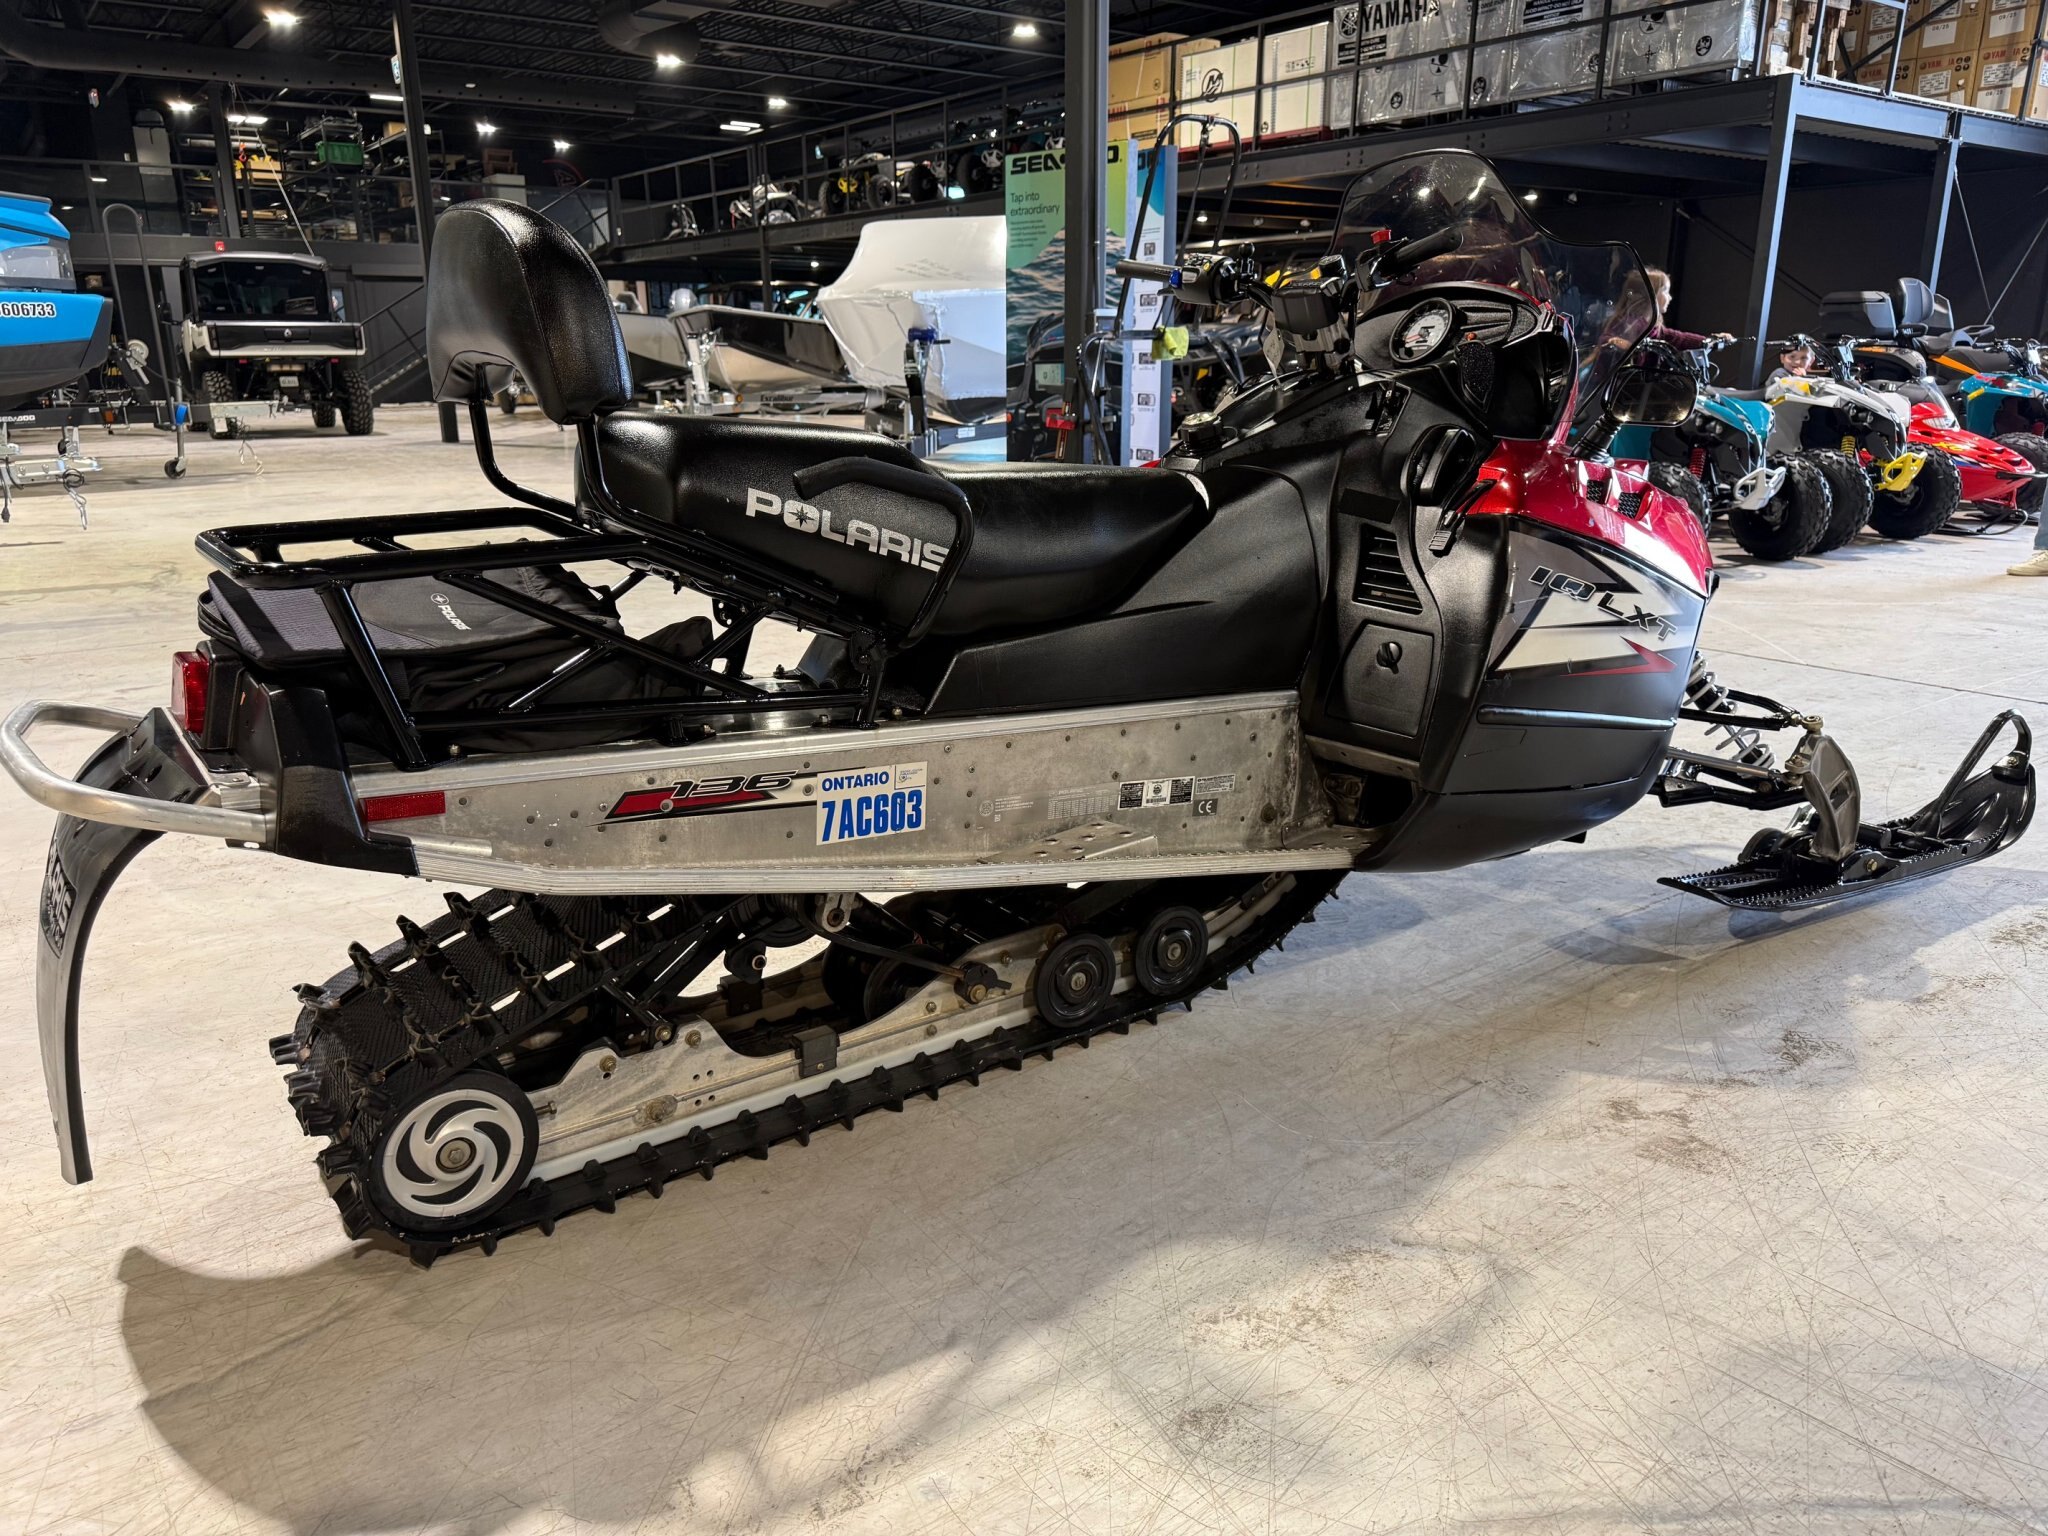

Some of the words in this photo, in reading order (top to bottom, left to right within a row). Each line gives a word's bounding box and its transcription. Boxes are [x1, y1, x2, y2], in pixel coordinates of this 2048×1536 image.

[1011, 193, 1024, 204] Tap
[1025, 192, 1040, 201] into
[1011, 204, 1060, 217] extraordinary
[745, 487, 950, 573] POLARIS
[437, 604, 472, 631] POLARIS
[1597, 591, 1678, 641] LXT
[669, 770, 799, 800] 136
[822, 771, 890, 792] ONTARIO
[822, 789, 923, 842] 7AC603
